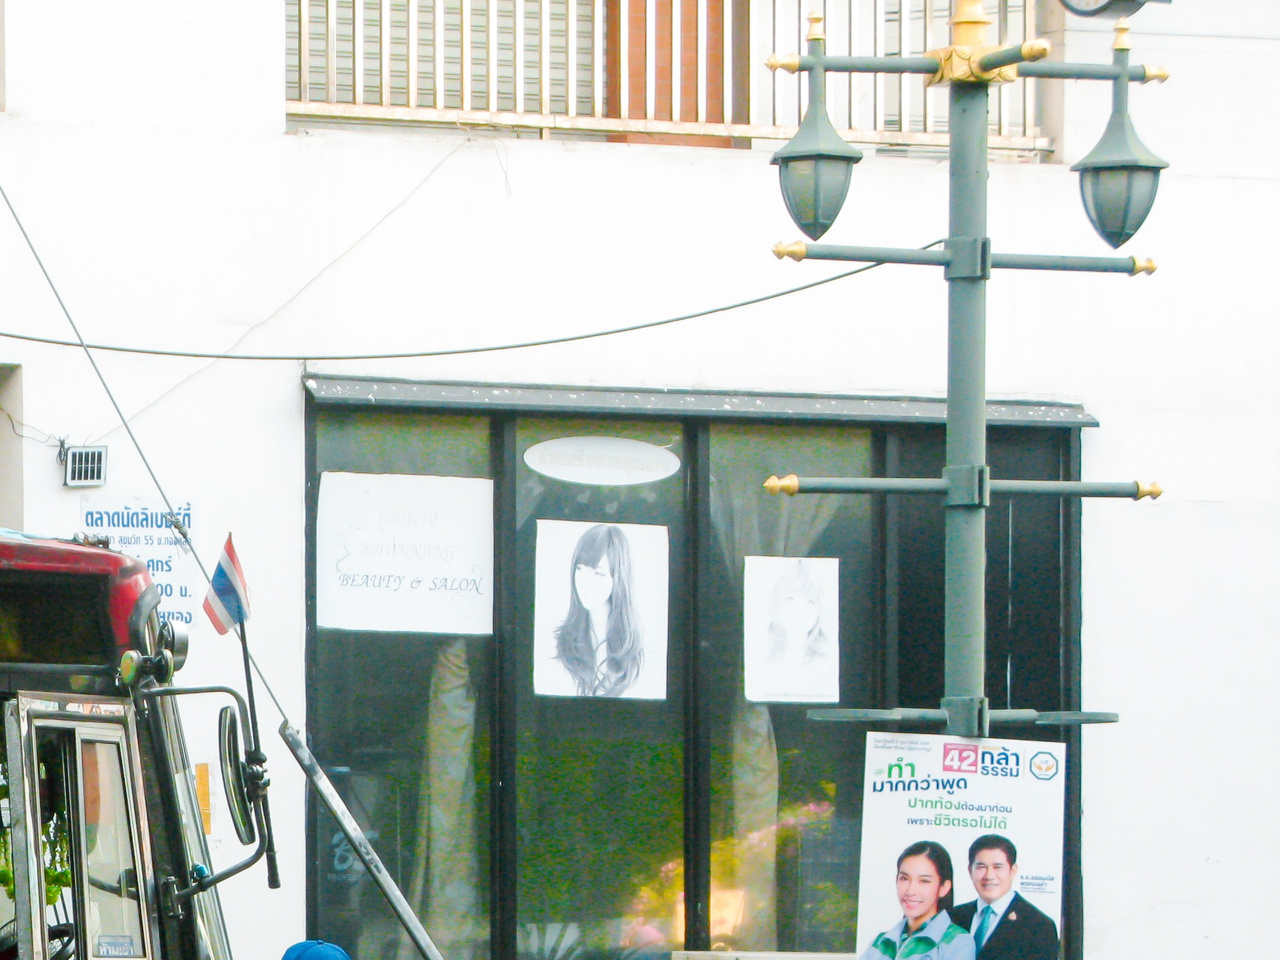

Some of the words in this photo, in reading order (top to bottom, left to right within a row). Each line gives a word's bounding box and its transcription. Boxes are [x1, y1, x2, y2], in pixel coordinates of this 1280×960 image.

[144, 534, 154, 546] 55
[338, 573, 406, 592] BEAUTY
[429, 576, 484, 595] SALON
[944, 749, 977, 771] 42
[981, 746, 1020, 767] กล้า
[981, 765, 1020, 778] ธรรม
[872, 774, 968, 796] มากกว่าพูด
